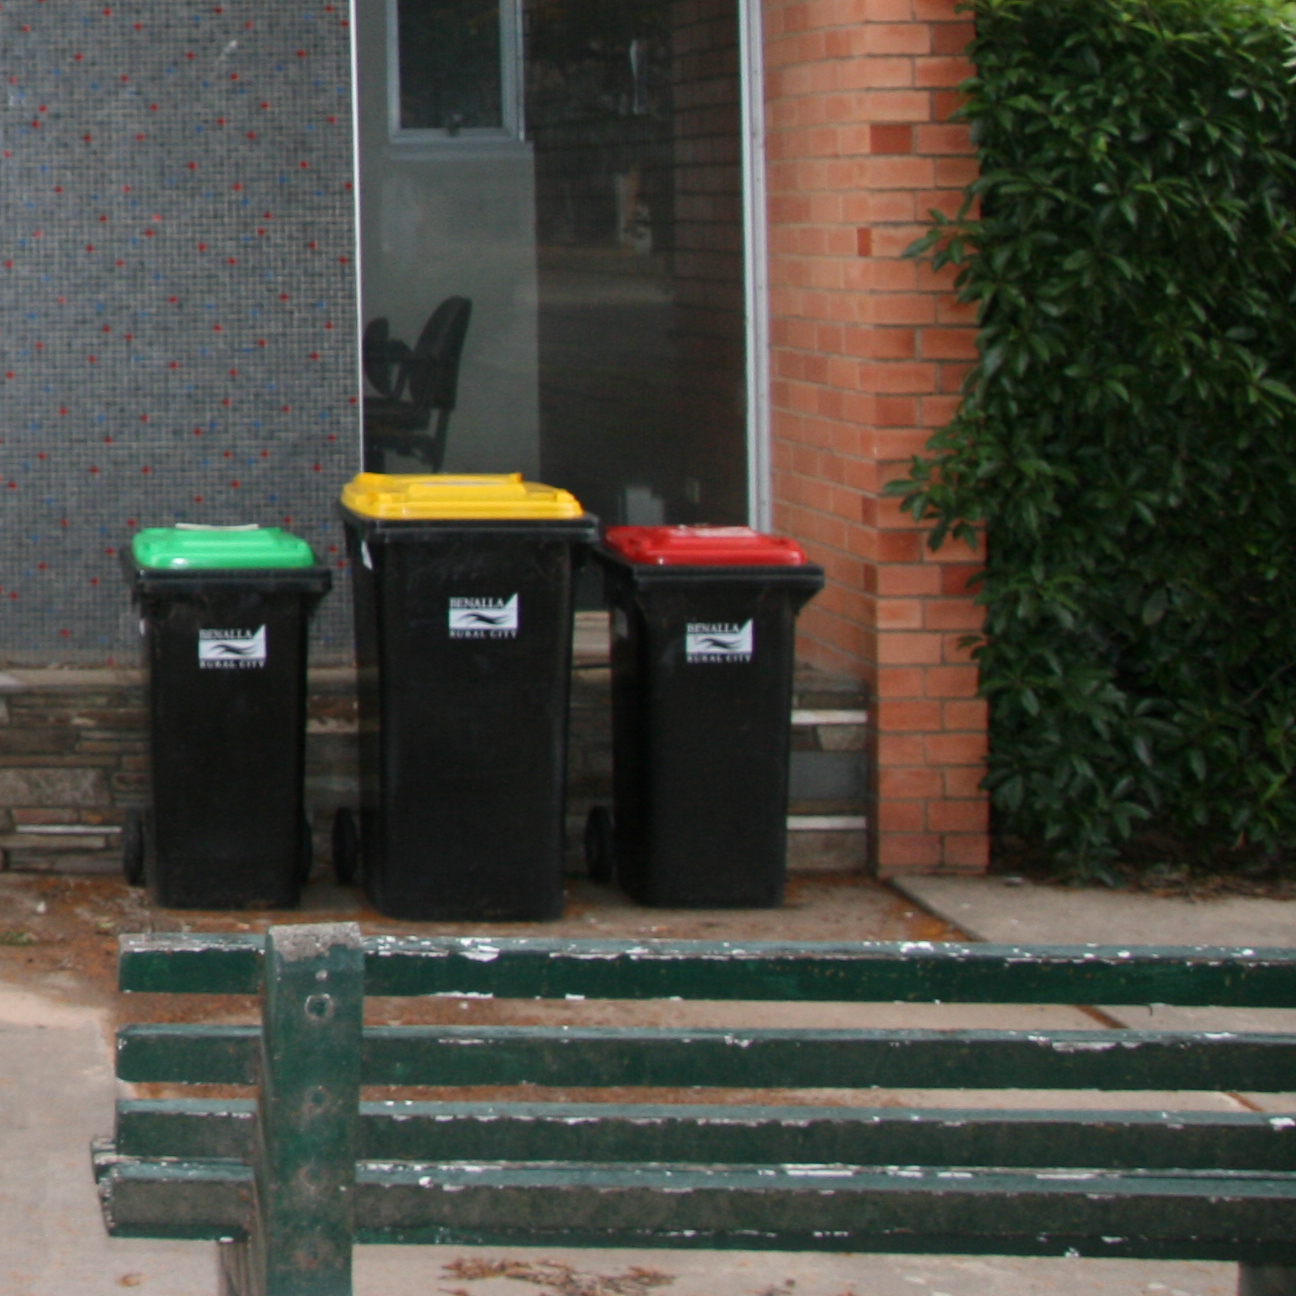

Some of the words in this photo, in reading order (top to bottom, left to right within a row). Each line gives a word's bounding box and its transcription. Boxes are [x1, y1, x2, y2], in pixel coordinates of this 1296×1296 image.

[449, 597, 504, 608] BENALLA
[687, 623, 740, 633] BENALLA
[199, 629, 253, 639] BENALLA
[489, 630, 518, 639] CITY
